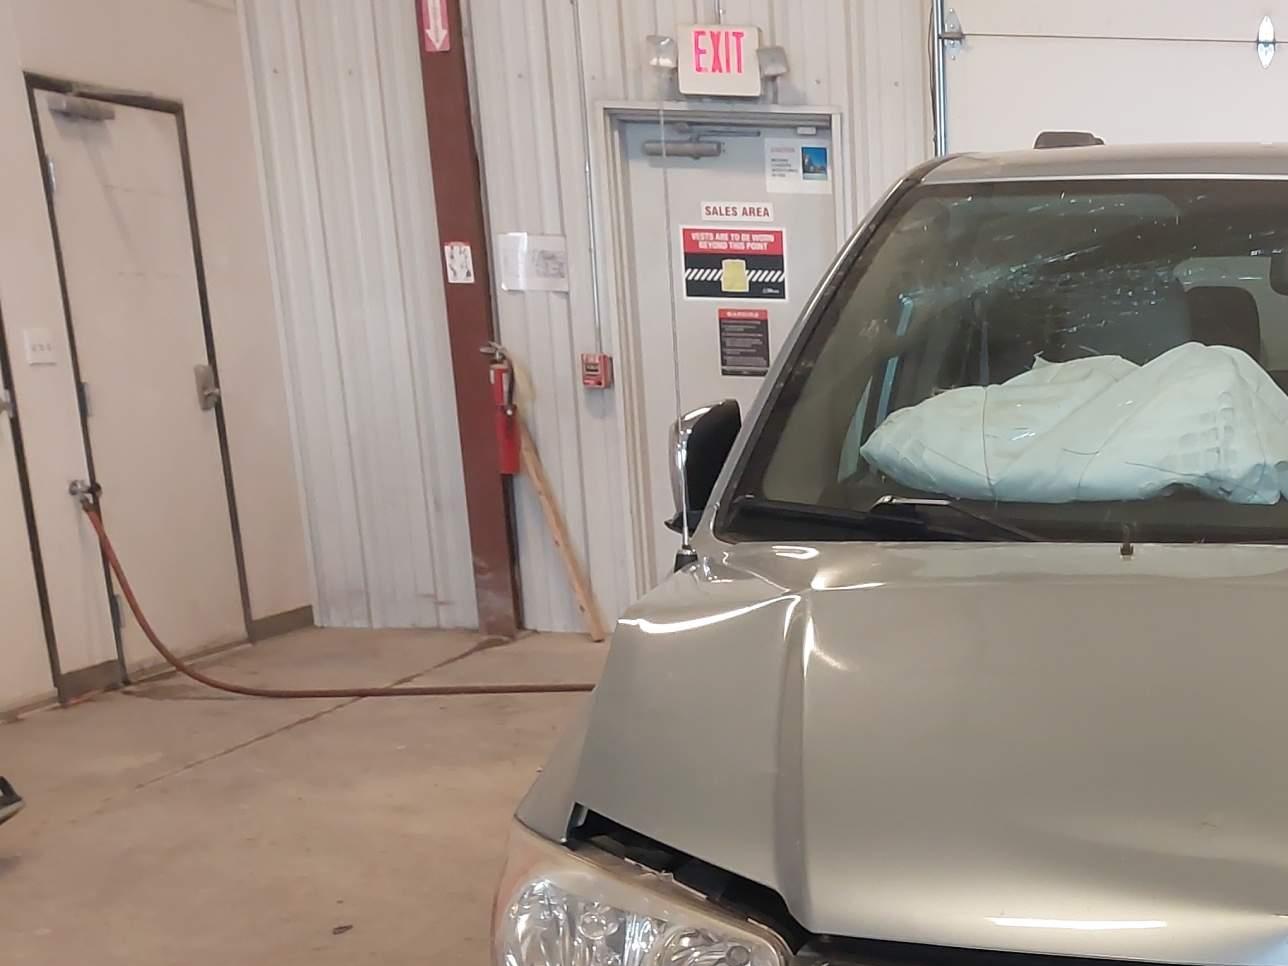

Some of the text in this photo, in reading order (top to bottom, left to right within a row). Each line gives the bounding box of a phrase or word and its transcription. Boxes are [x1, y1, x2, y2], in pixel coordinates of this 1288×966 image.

[693, 31, 744, 73] EXIT
[705, 206, 769, 217] SALES AREA
[715, 232, 729, 241] ARE
[731, 233, 740, 241] TO
[741, 234, 750, 242] BE
[698, 241, 768, 250] BEYOND THIS POINT
